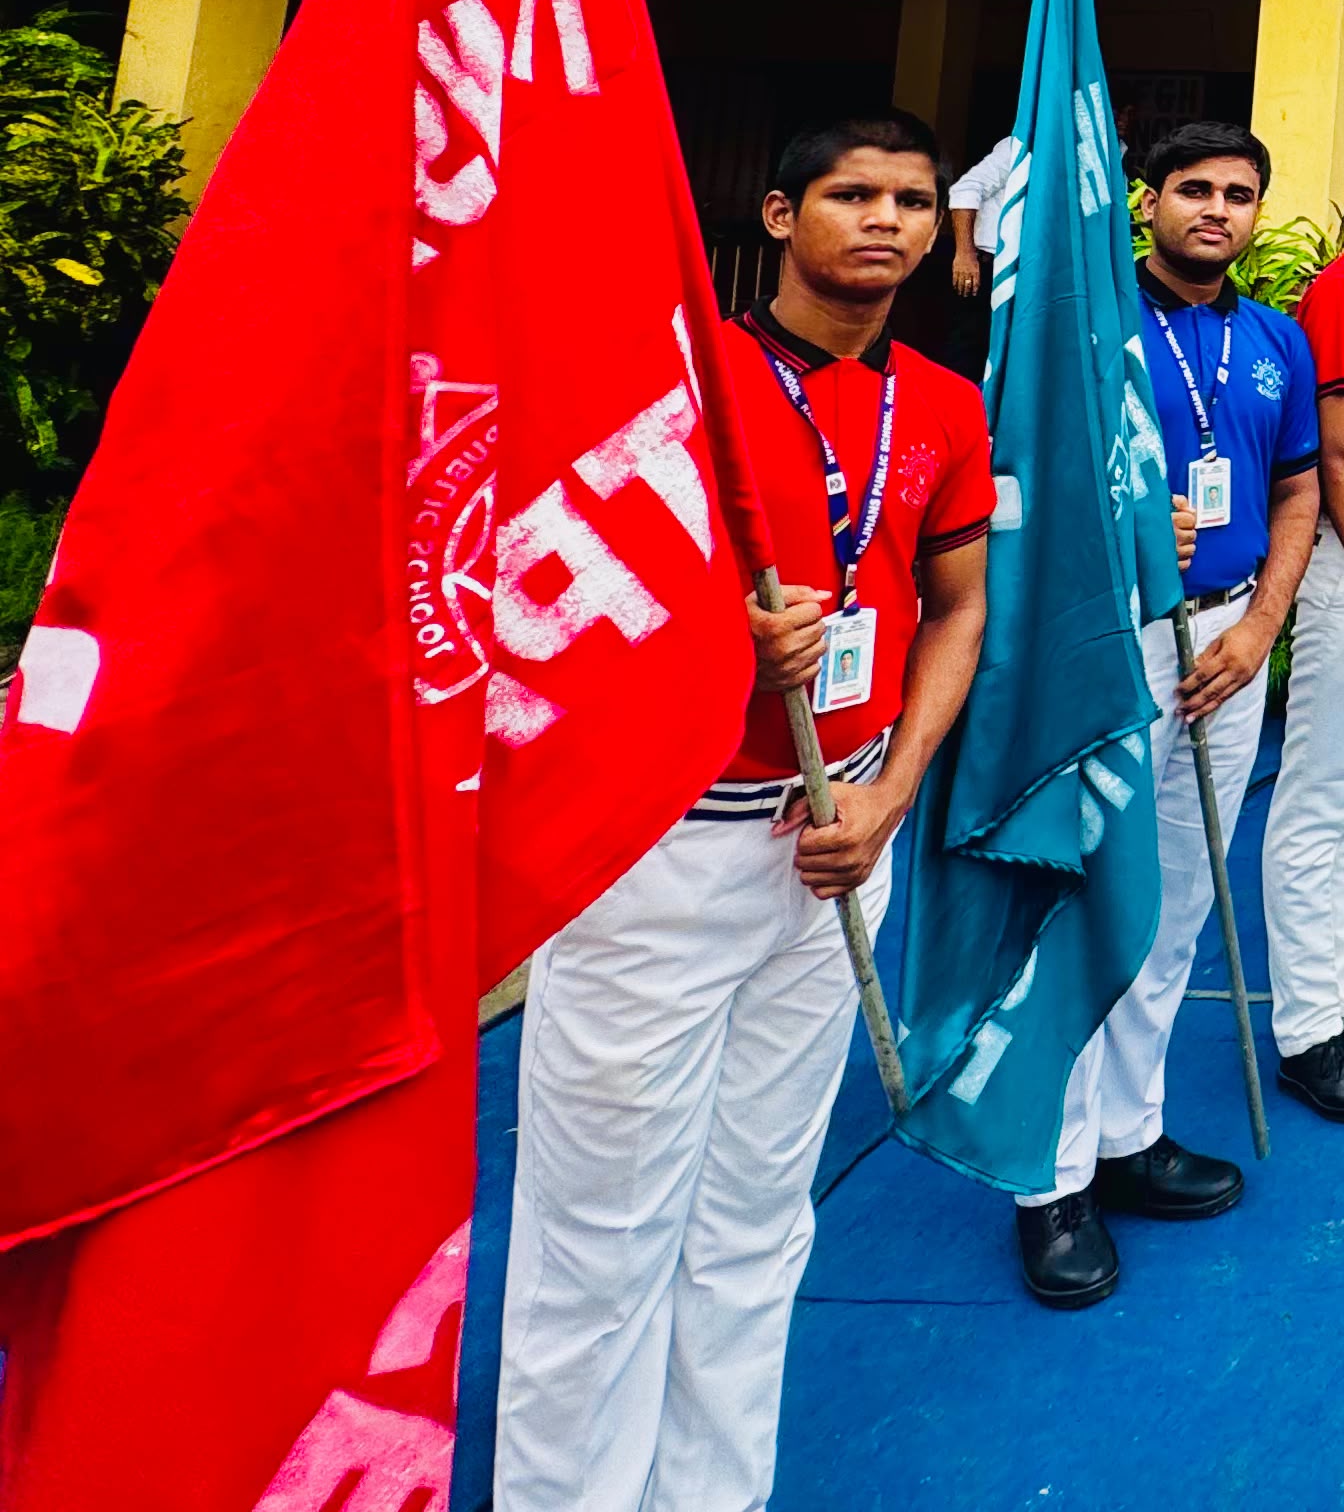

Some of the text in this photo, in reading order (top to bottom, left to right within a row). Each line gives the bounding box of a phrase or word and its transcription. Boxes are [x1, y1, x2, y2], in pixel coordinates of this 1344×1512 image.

[879, 407, 895, 453] SCHOOL,
[871, 454, 889, 497] PUBLIC
[855, 498, 882, 555] RAJHANS
